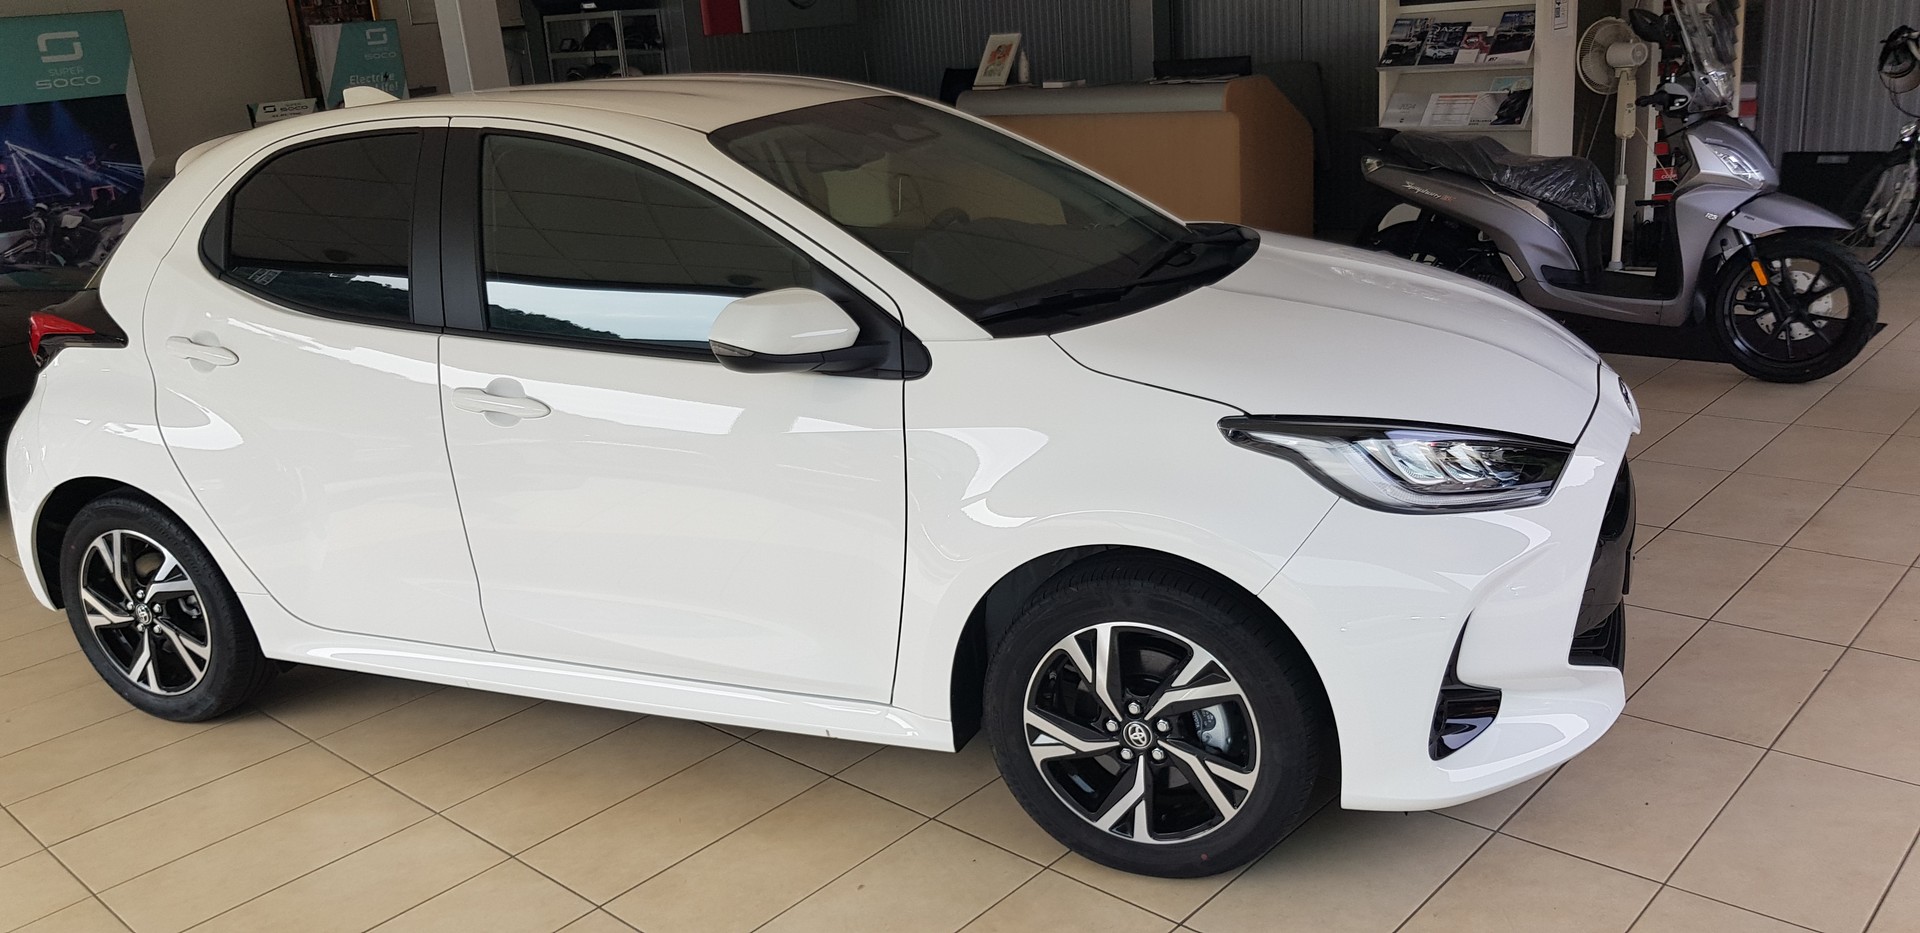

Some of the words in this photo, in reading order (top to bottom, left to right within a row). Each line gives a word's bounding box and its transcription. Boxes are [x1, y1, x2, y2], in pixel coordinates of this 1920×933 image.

[1433, 25, 1463, 34] JAZZ
[364, 52, 397, 60] SOCO
[48, 66, 84, 76] SUPER
[35, 75, 101, 89] SOCO
[1192, 710, 1200, 728] OYOTA
